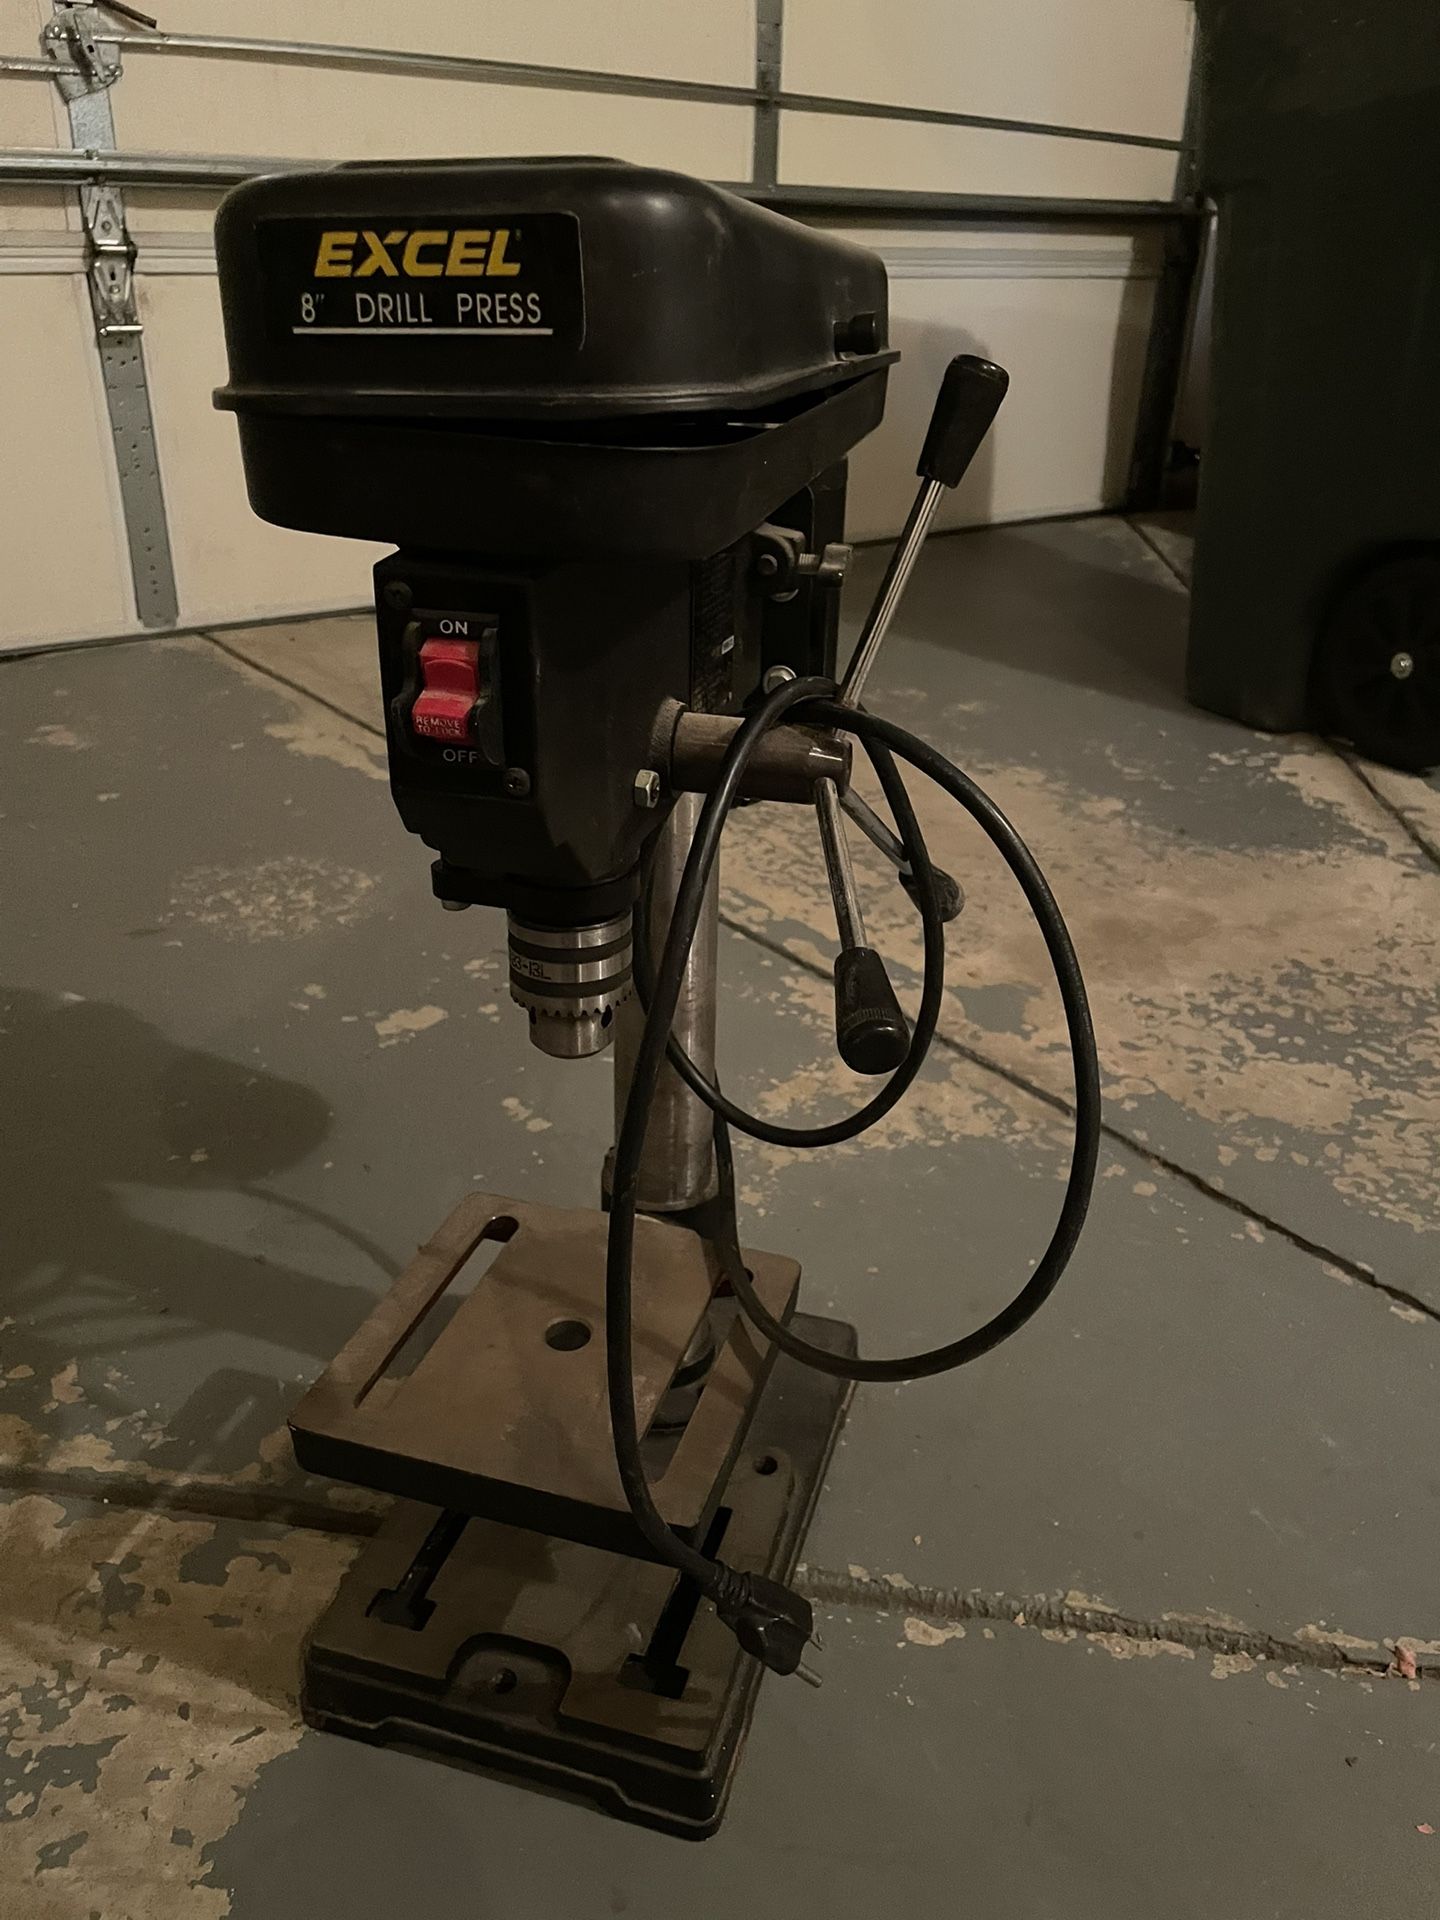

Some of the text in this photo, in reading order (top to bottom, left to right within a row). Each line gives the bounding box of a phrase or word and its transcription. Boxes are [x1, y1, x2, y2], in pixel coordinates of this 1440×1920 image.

[314, 229, 521, 278] EXCEL
[355, 293, 433, 323] DRILL
[457, 293, 542, 324] PRESS
[439, 619, 469, 635] ON
[416, 715, 461, 729] REMOVE
[442, 748, 480, 764] OFF
